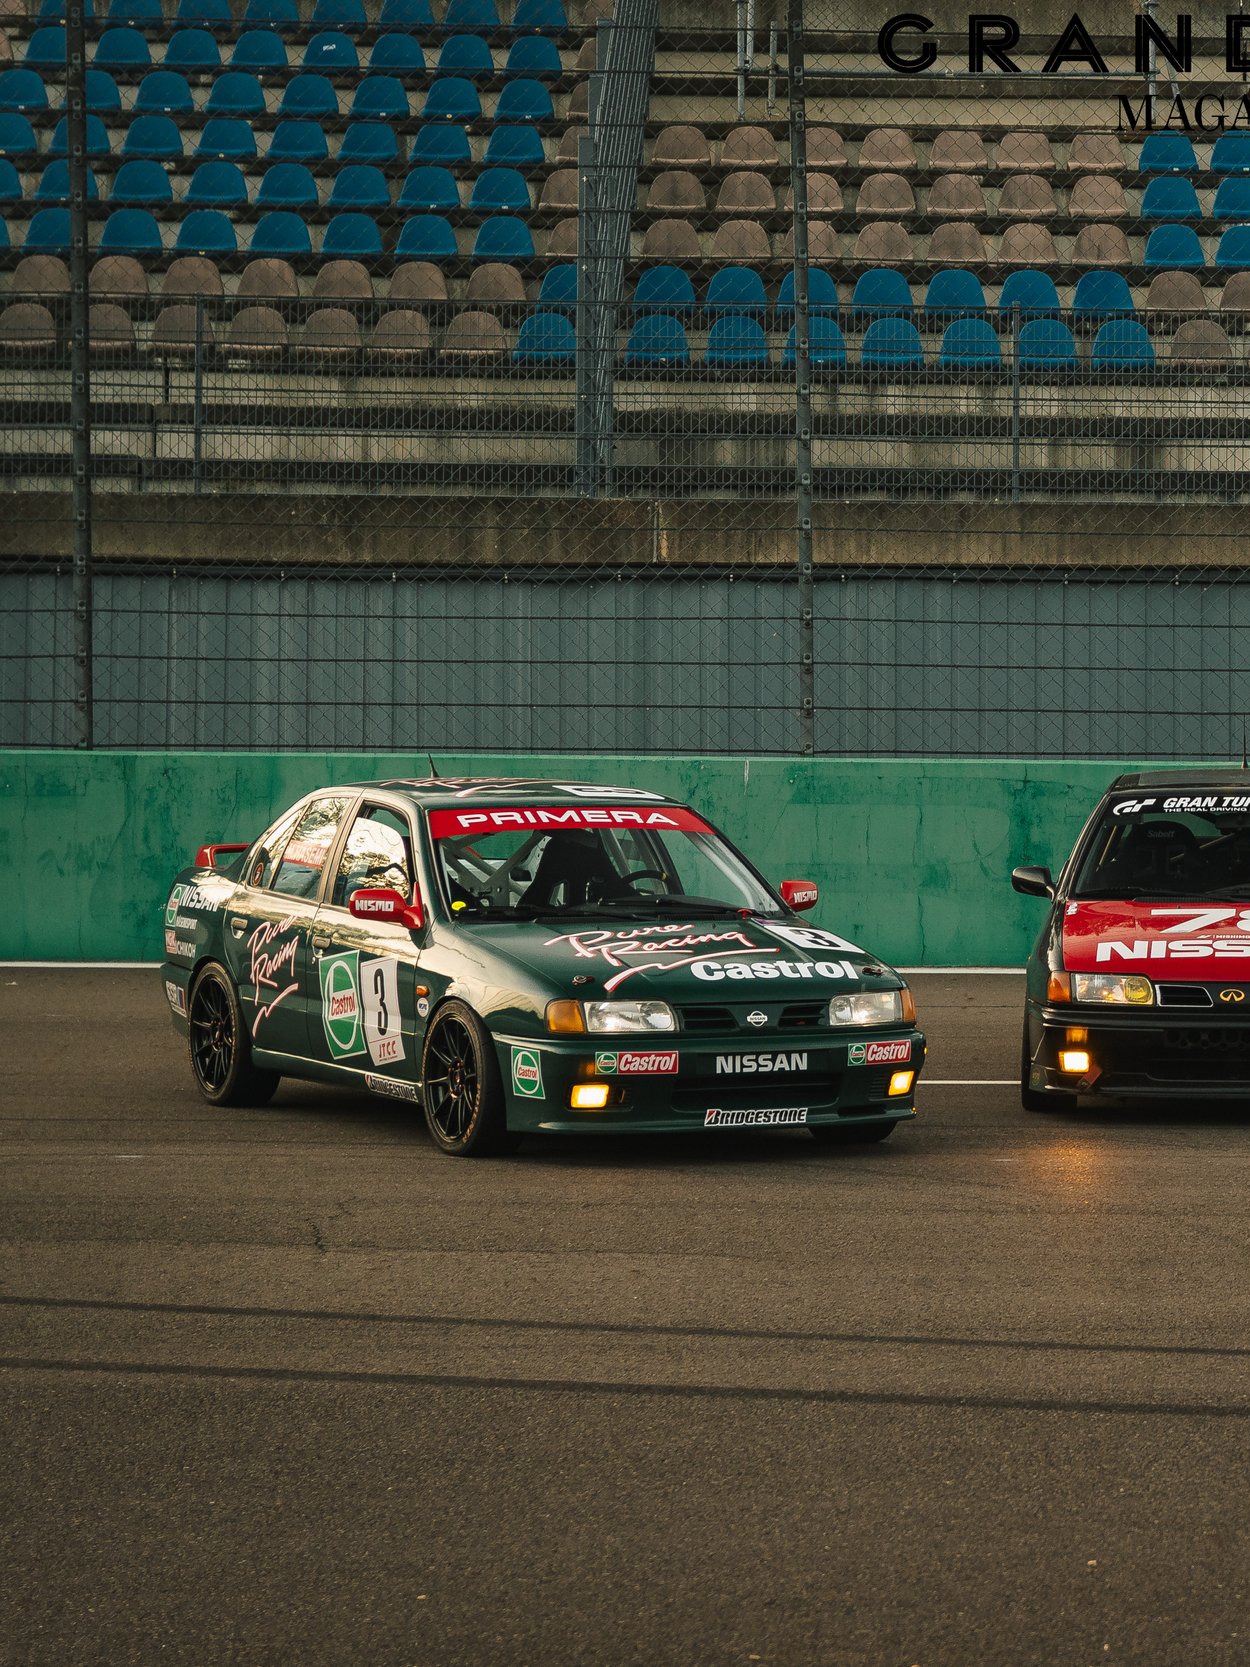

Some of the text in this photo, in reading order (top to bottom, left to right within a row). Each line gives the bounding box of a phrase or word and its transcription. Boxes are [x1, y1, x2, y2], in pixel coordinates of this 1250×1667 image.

[1162, 797, 1218, 808] GRAN
[456, 810, 680, 828] PRIMERA
[179, 885, 220, 912] NISSAN
[355, 900, 394, 912] NISMO
[793, 890, 818, 903] NISMO
[543, 924, 694, 958] Pure
[788, 928, 842, 947] 3
[585, 931, 757, 967] Racing
[690, 960, 860, 981] Castrol
[331, 992, 356, 1017] Castrol
[374, 968, 389, 1036] 3
[378, 1040, 397, 1058] JTCC
[867, 1042, 910, 1062] Castrol
[619, 1053, 676, 1071] Castrol
[716, 1053, 808, 1074] NISSAN
[517, 1067, 538, 1079] Castrol
[704, 1108, 807, 1126] BRIDGESTONE
